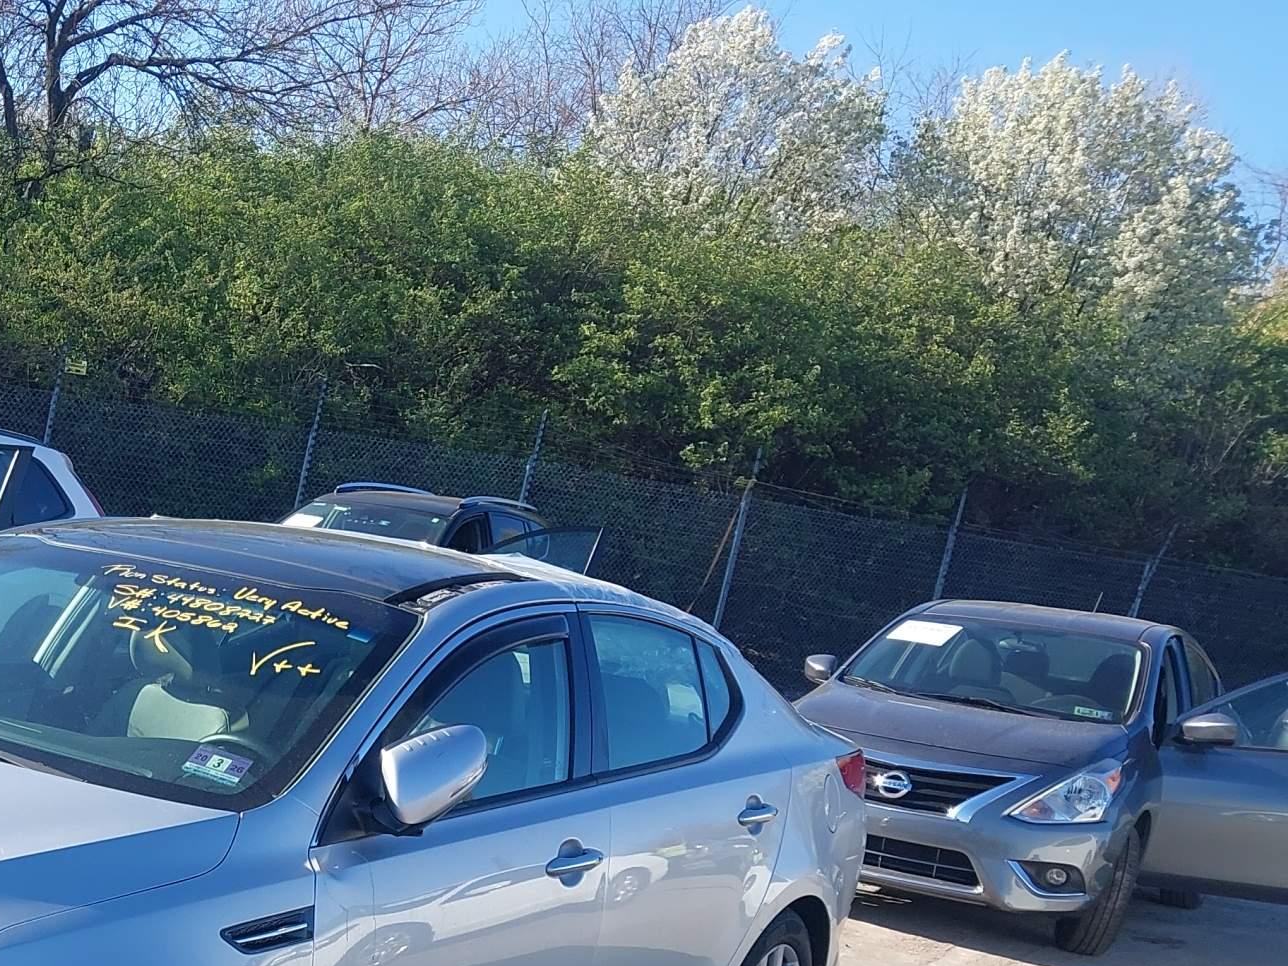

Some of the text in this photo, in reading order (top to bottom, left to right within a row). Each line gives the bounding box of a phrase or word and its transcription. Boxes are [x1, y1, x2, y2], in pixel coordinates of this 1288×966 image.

[233, 586, 278, 611] Very
[280, 600, 350, 630] Active
[194, 752, 209, 762] 20
[212, 758, 225, 769] 3
[229, 764, 245, 774] 26
